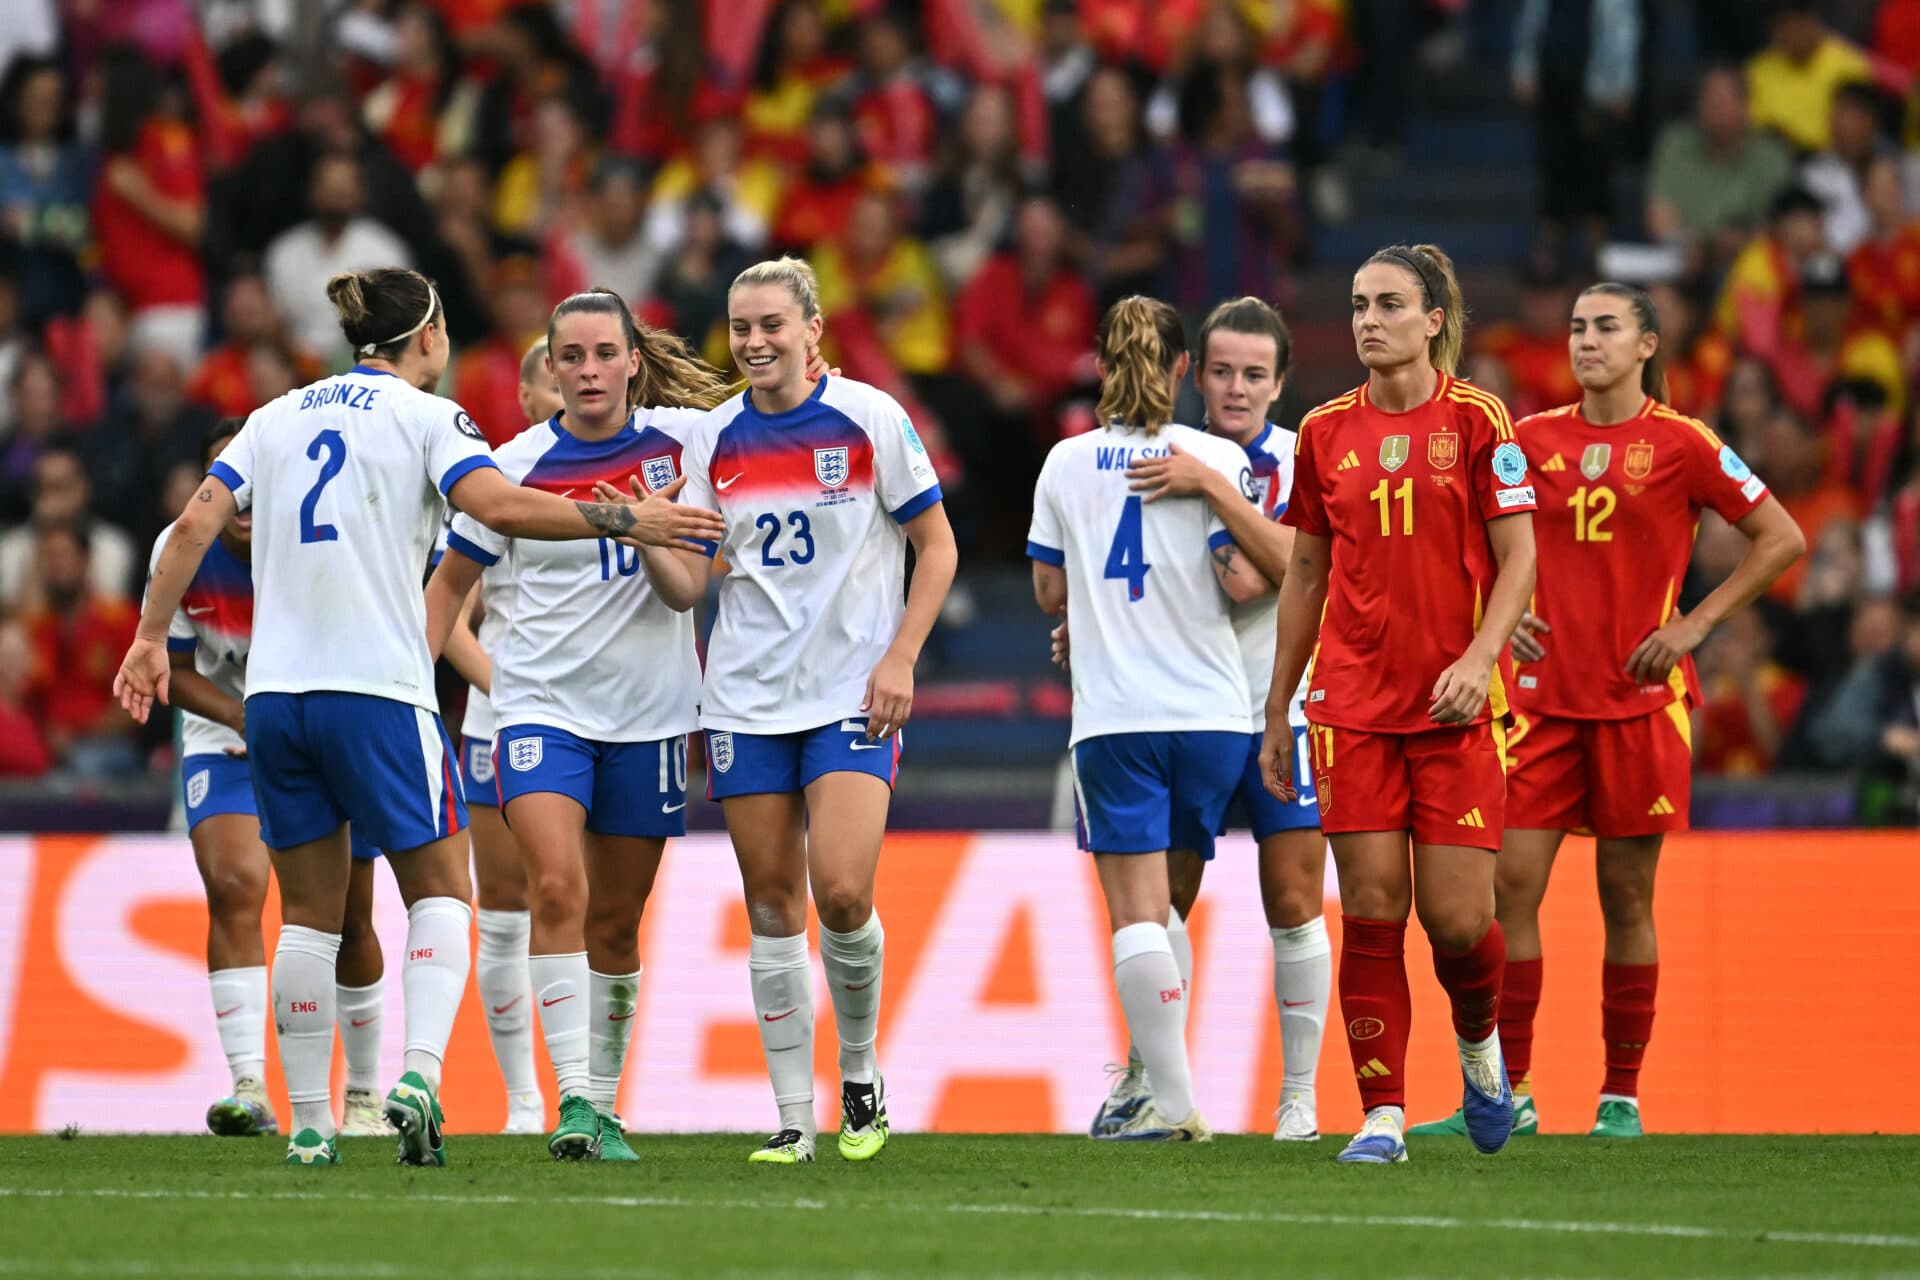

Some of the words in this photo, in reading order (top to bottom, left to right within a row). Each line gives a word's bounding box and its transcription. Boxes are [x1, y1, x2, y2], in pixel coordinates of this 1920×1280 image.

[299, 383, 381, 411] BRONZE
[299, 428, 347, 545] 2
[1369, 477, 1414, 537] 11
[1567, 485, 1617, 543] 12
[598, 537, 640, 581] 10
[755, 510, 816, 568] 23
[1103, 494, 1152, 603] 4
[659, 735, 688, 793] 10
[409, 947, 434, 961] ENG
[290, 1001, 318, 1013] ENG
[1159, 987, 1183, 1005] ENG
